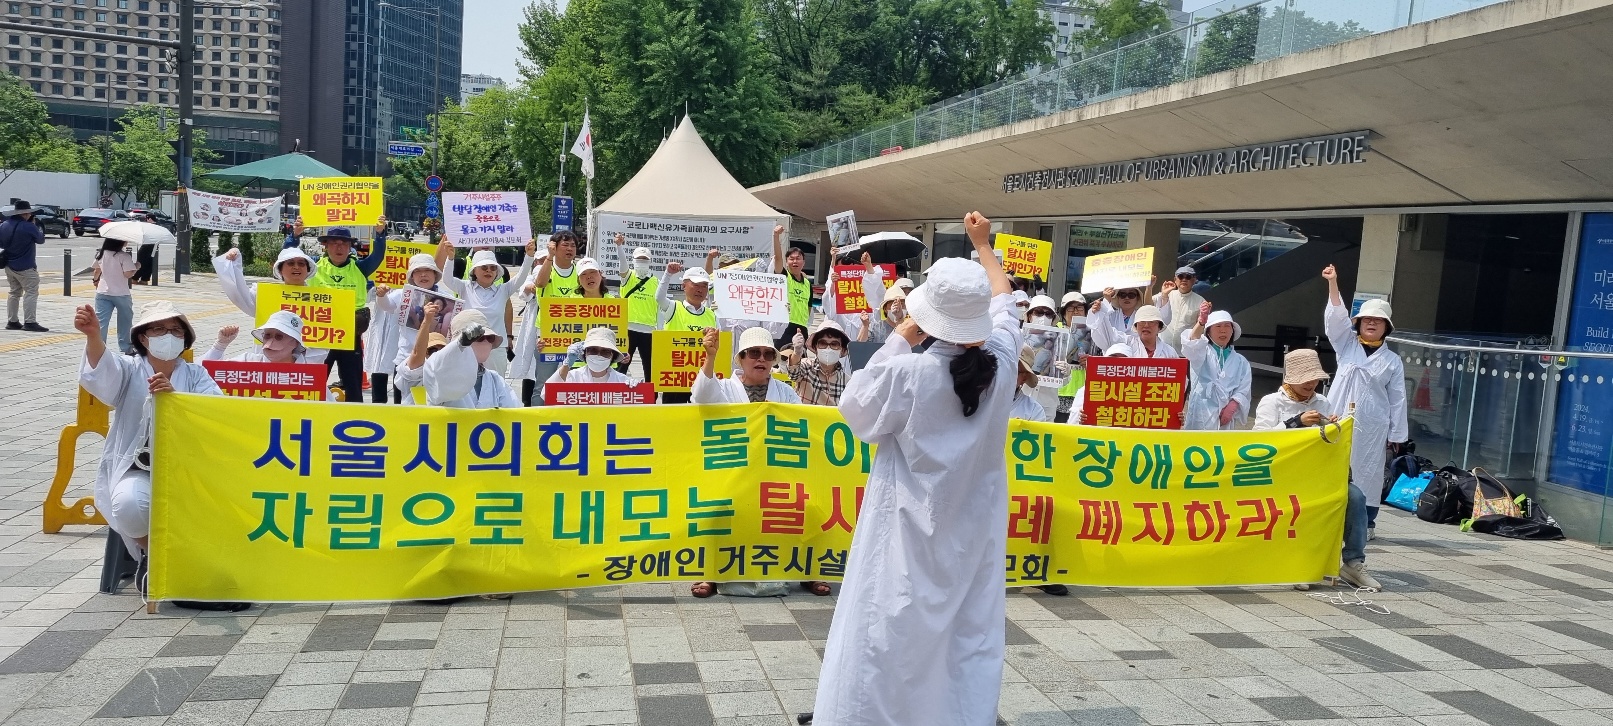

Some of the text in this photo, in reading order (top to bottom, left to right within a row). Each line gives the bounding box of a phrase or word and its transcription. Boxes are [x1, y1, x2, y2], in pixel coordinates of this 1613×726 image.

[1001, 136, 1365, 193] 서울도시건축전시관 SEOUL HALL OF URBANISM & ARCHITECTURE
[303, 182, 379, 191] UN 장애인권리협약을
[312, 192, 370, 206] 왜곡하지
[326, 208, 357, 222] 말라
[479, 225, 495, 233] 가지
[387, 245, 421, 255] 누구를 위한
[1007, 248, 1037, 263] 탈시설
[385, 256, 409, 270] 탈시
[282, 291, 332, 304] 누구를 위한
[728, 284, 783, 301] 왜곡하지
[549, 304, 621, 318] 중증장애인
[741, 302, 772, 316] 말라
[550, 323, 583, 334] 사지로
[1586, 326, 1609, 339] Build
[672, 337, 696, 347] 누구를
[214, 370, 314, 386] 특정단체 배불리는
[1096, 365, 1176, 378] 특정단체 배불리는
[556, 392, 644, 404] 특정단체 배불리는
[1089, 381, 1181, 402] 탈시설 조례
[1096, 406, 1170, 427] 철회하라
[253, 418, 654, 478] 서울시의회는
[1072, 438, 1278, 489] 장애인을
[247, 492, 525, 550] 자립으로
[552, 487, 735, 545] 내모는
[759, 481, 866, 534] 탈시
[1076, 494, 1298, 546] 폐지하라!
[603, 546, 706, 582] 장애인
[719, 543, 848, 580] 거주시설
